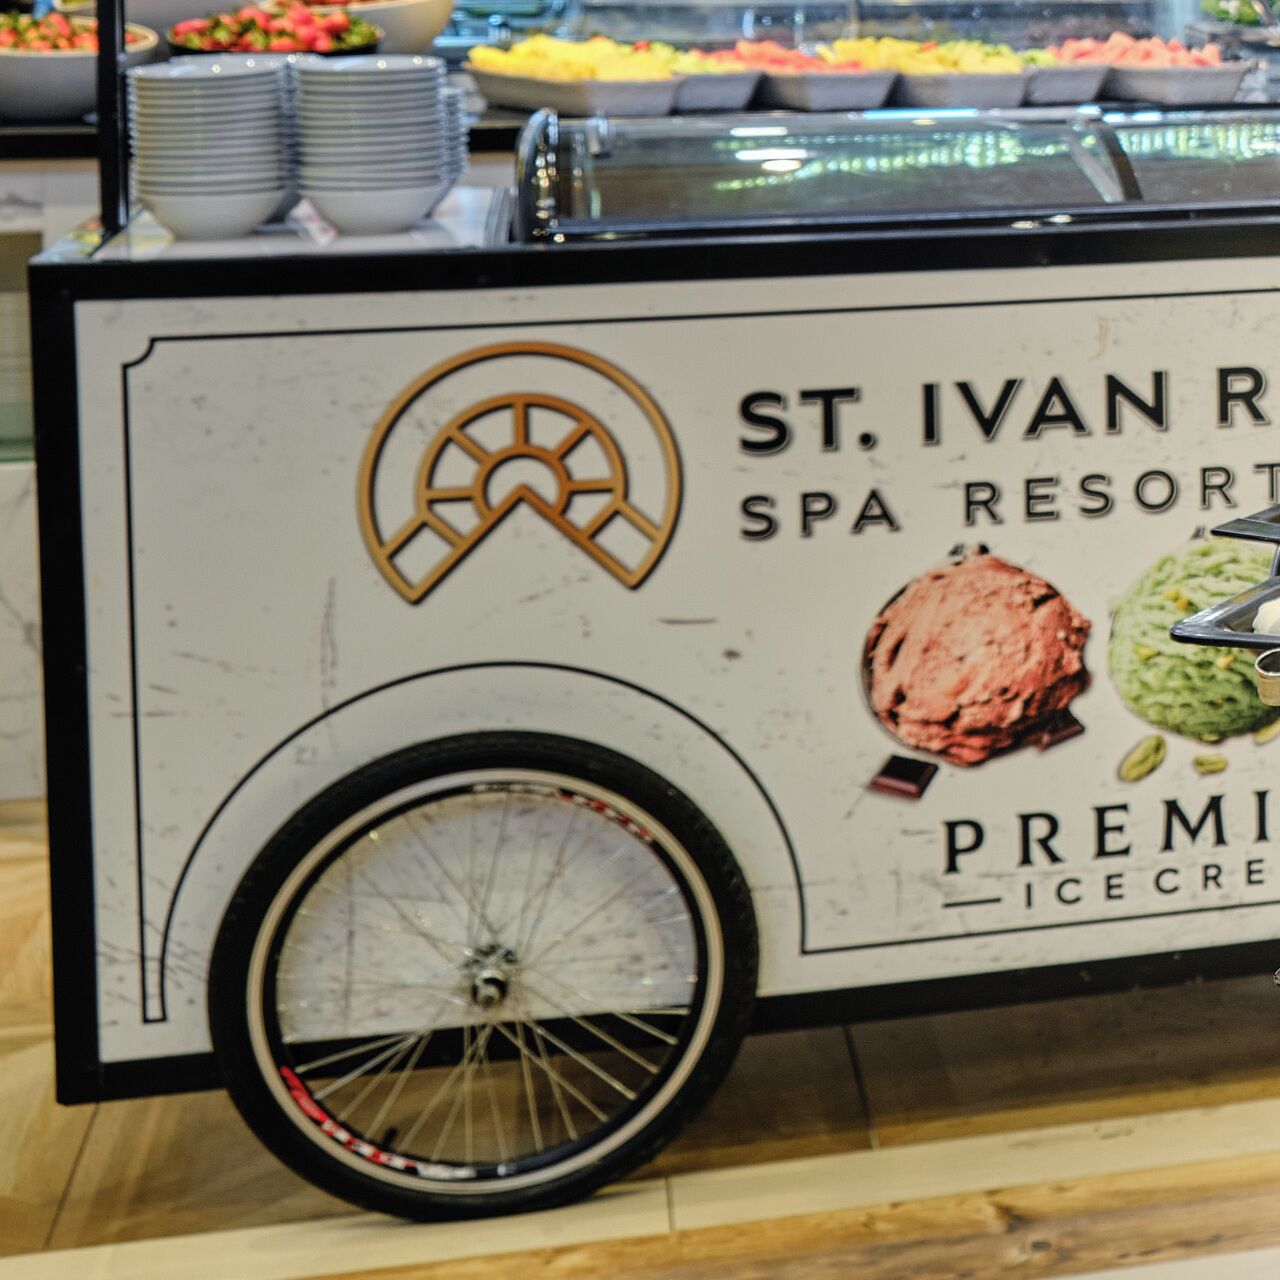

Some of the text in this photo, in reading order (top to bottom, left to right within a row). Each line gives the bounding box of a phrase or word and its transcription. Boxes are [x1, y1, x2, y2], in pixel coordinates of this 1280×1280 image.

[738, 386, 878, 458] ST.
[921, 369, 1167, 447] IVAN
[739, 488, 902, 543] SPA
